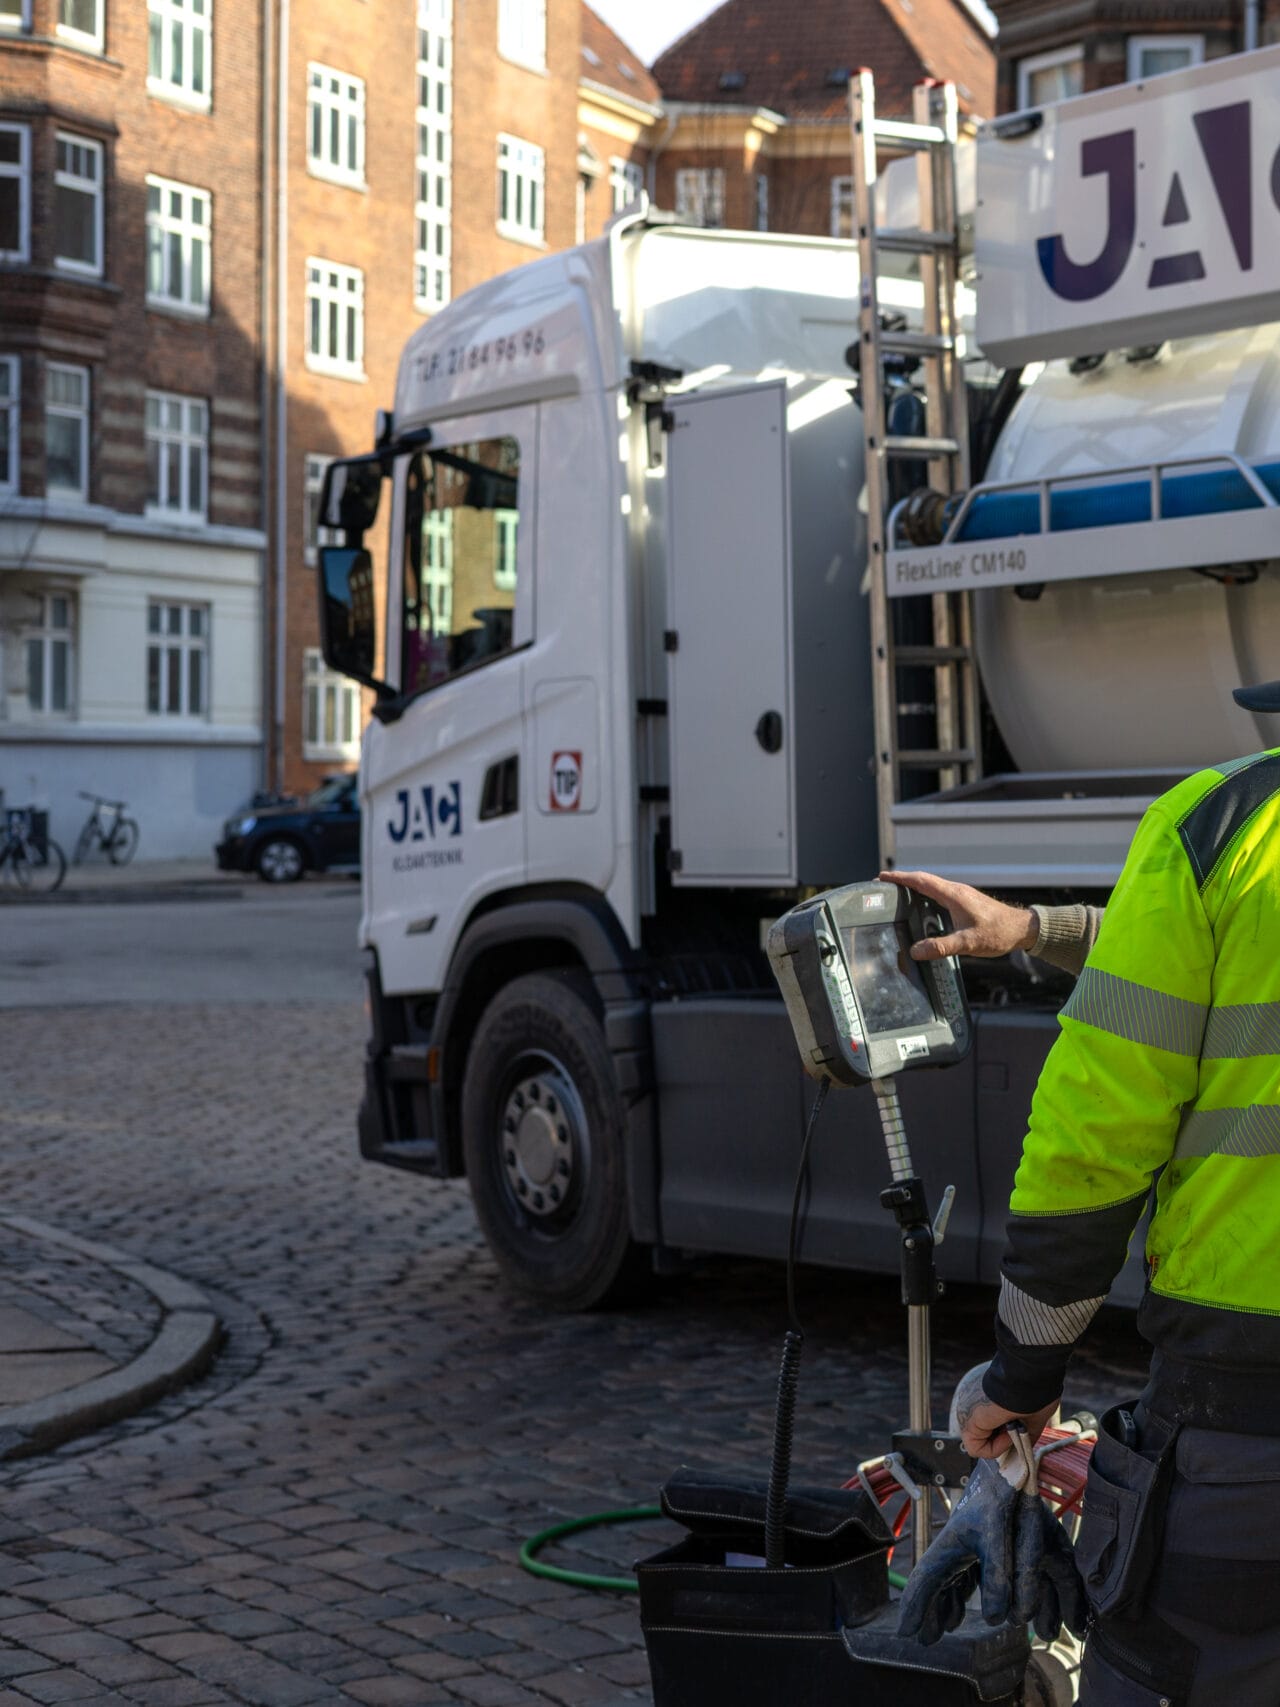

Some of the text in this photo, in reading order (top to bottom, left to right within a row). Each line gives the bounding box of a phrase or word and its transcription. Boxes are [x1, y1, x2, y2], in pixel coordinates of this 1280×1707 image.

[969, 549, 1027, 577] CM140
[555, 770, 579, 796] TIP
[388, 781, 462, 843] JAC
